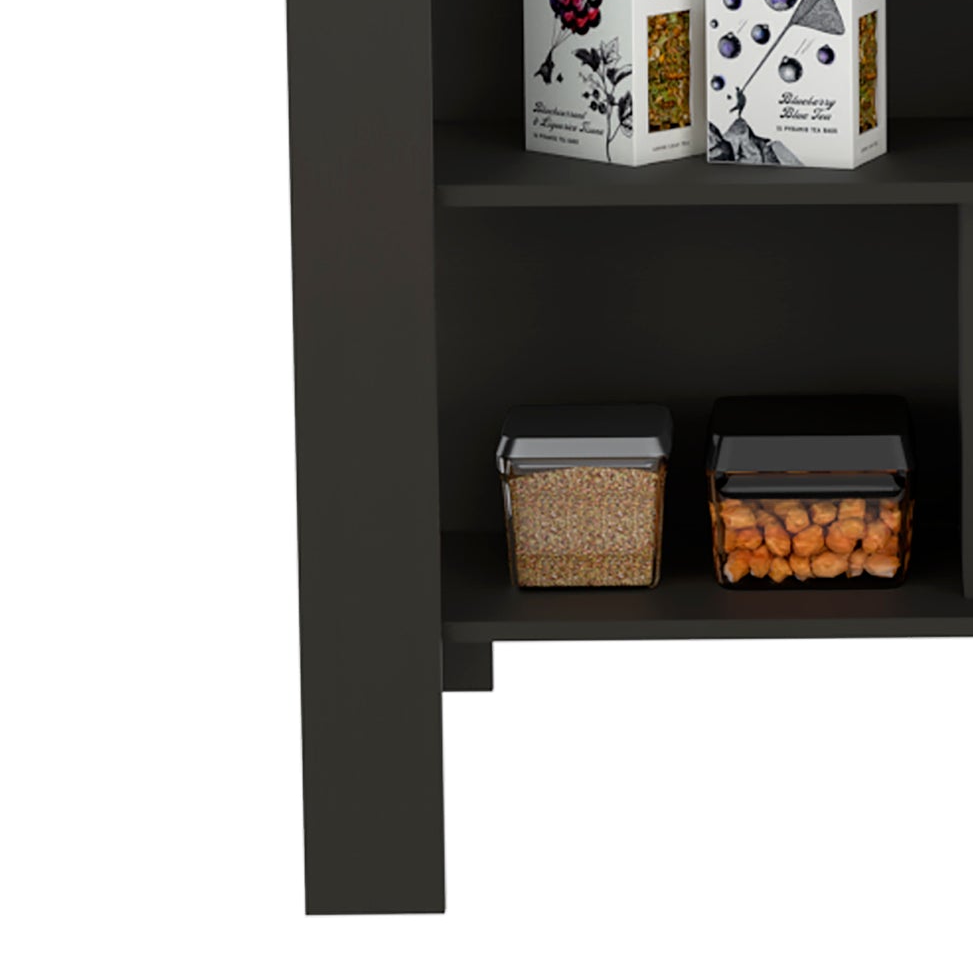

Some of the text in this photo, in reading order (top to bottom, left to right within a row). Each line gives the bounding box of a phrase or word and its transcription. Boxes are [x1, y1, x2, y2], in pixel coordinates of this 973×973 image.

[778, 91, 837, 110] Blueberry
[779, 106, 832, 121] Blue Tea
